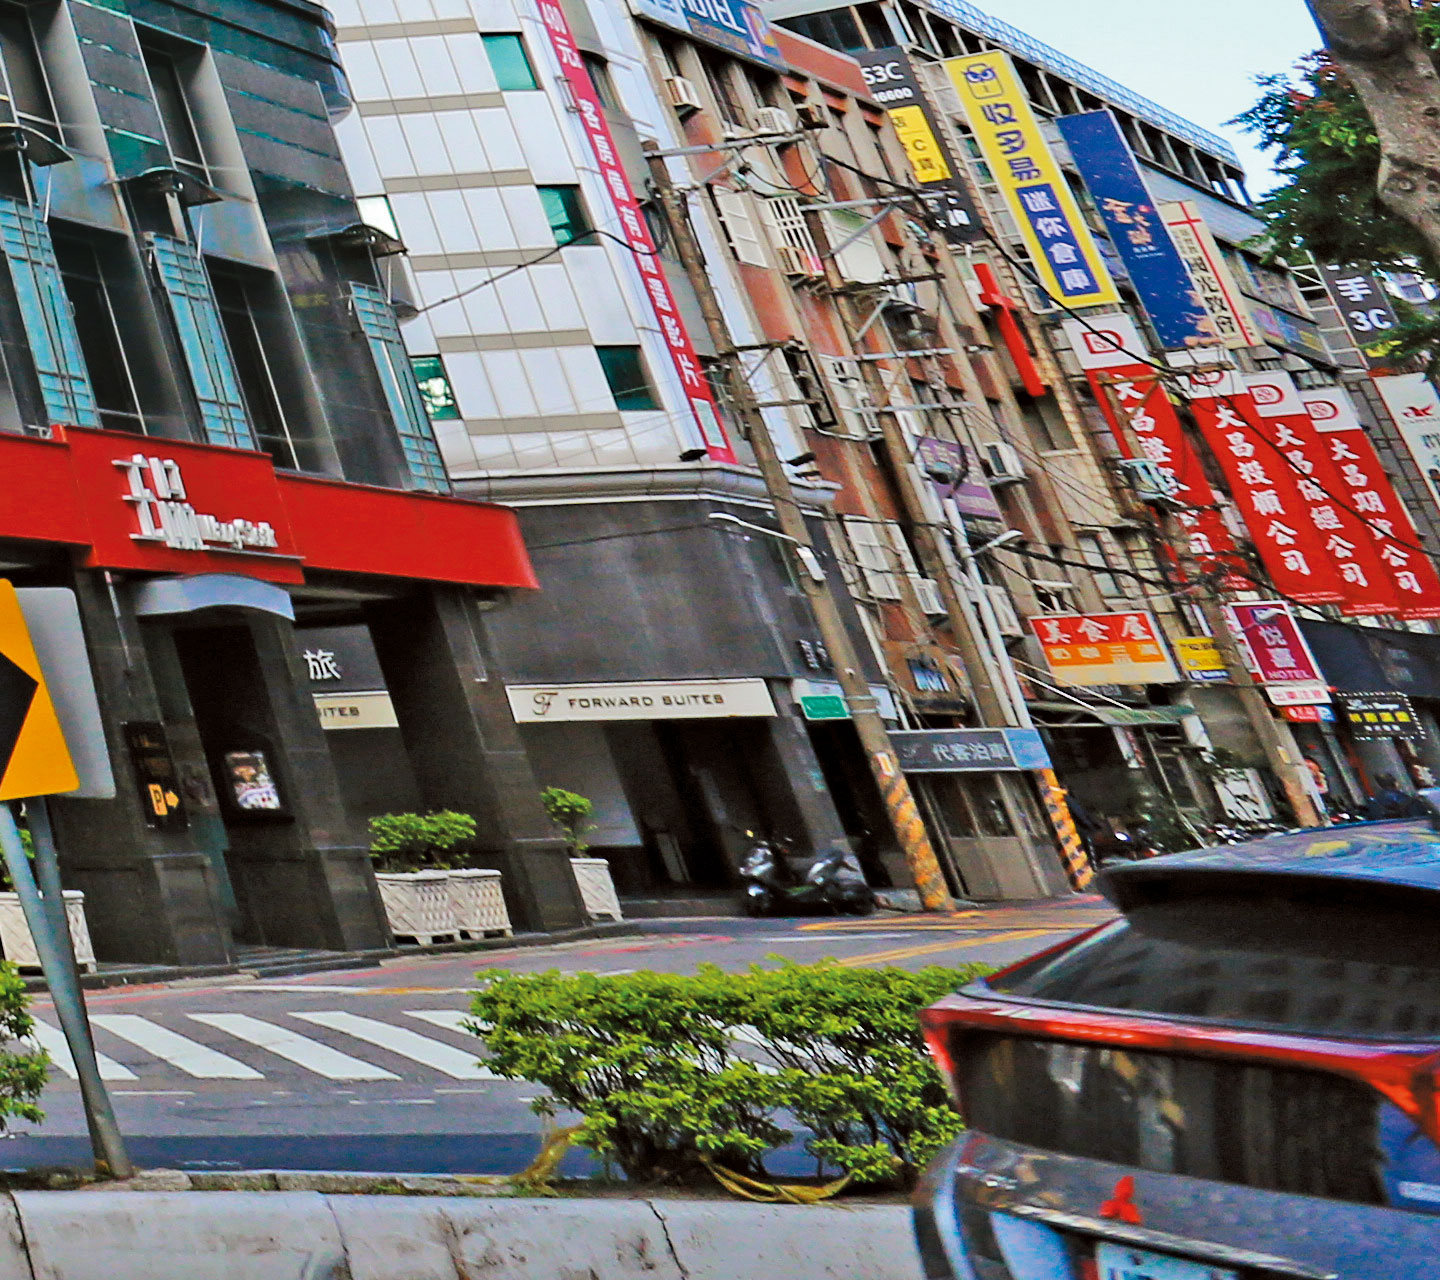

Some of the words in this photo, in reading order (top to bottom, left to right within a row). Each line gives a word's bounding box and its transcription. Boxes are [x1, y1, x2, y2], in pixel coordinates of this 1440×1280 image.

[1023, 191, 1091, 290] 迷你倉庫
[1348, 308, 1392, 332] 3C
[1215, 404, 1311, 576] 大昌投顧公司
[1042, 615, 1153, 644] 美食屋
[303, 648, 341, 680] 旅
[1268, 670, 1312, 680] HOTEL
[568, 695, 654, 709] FORWARD
[662, 693, 725, 707] SUITES
[932, 742, 1011, 762] 代客泊車
